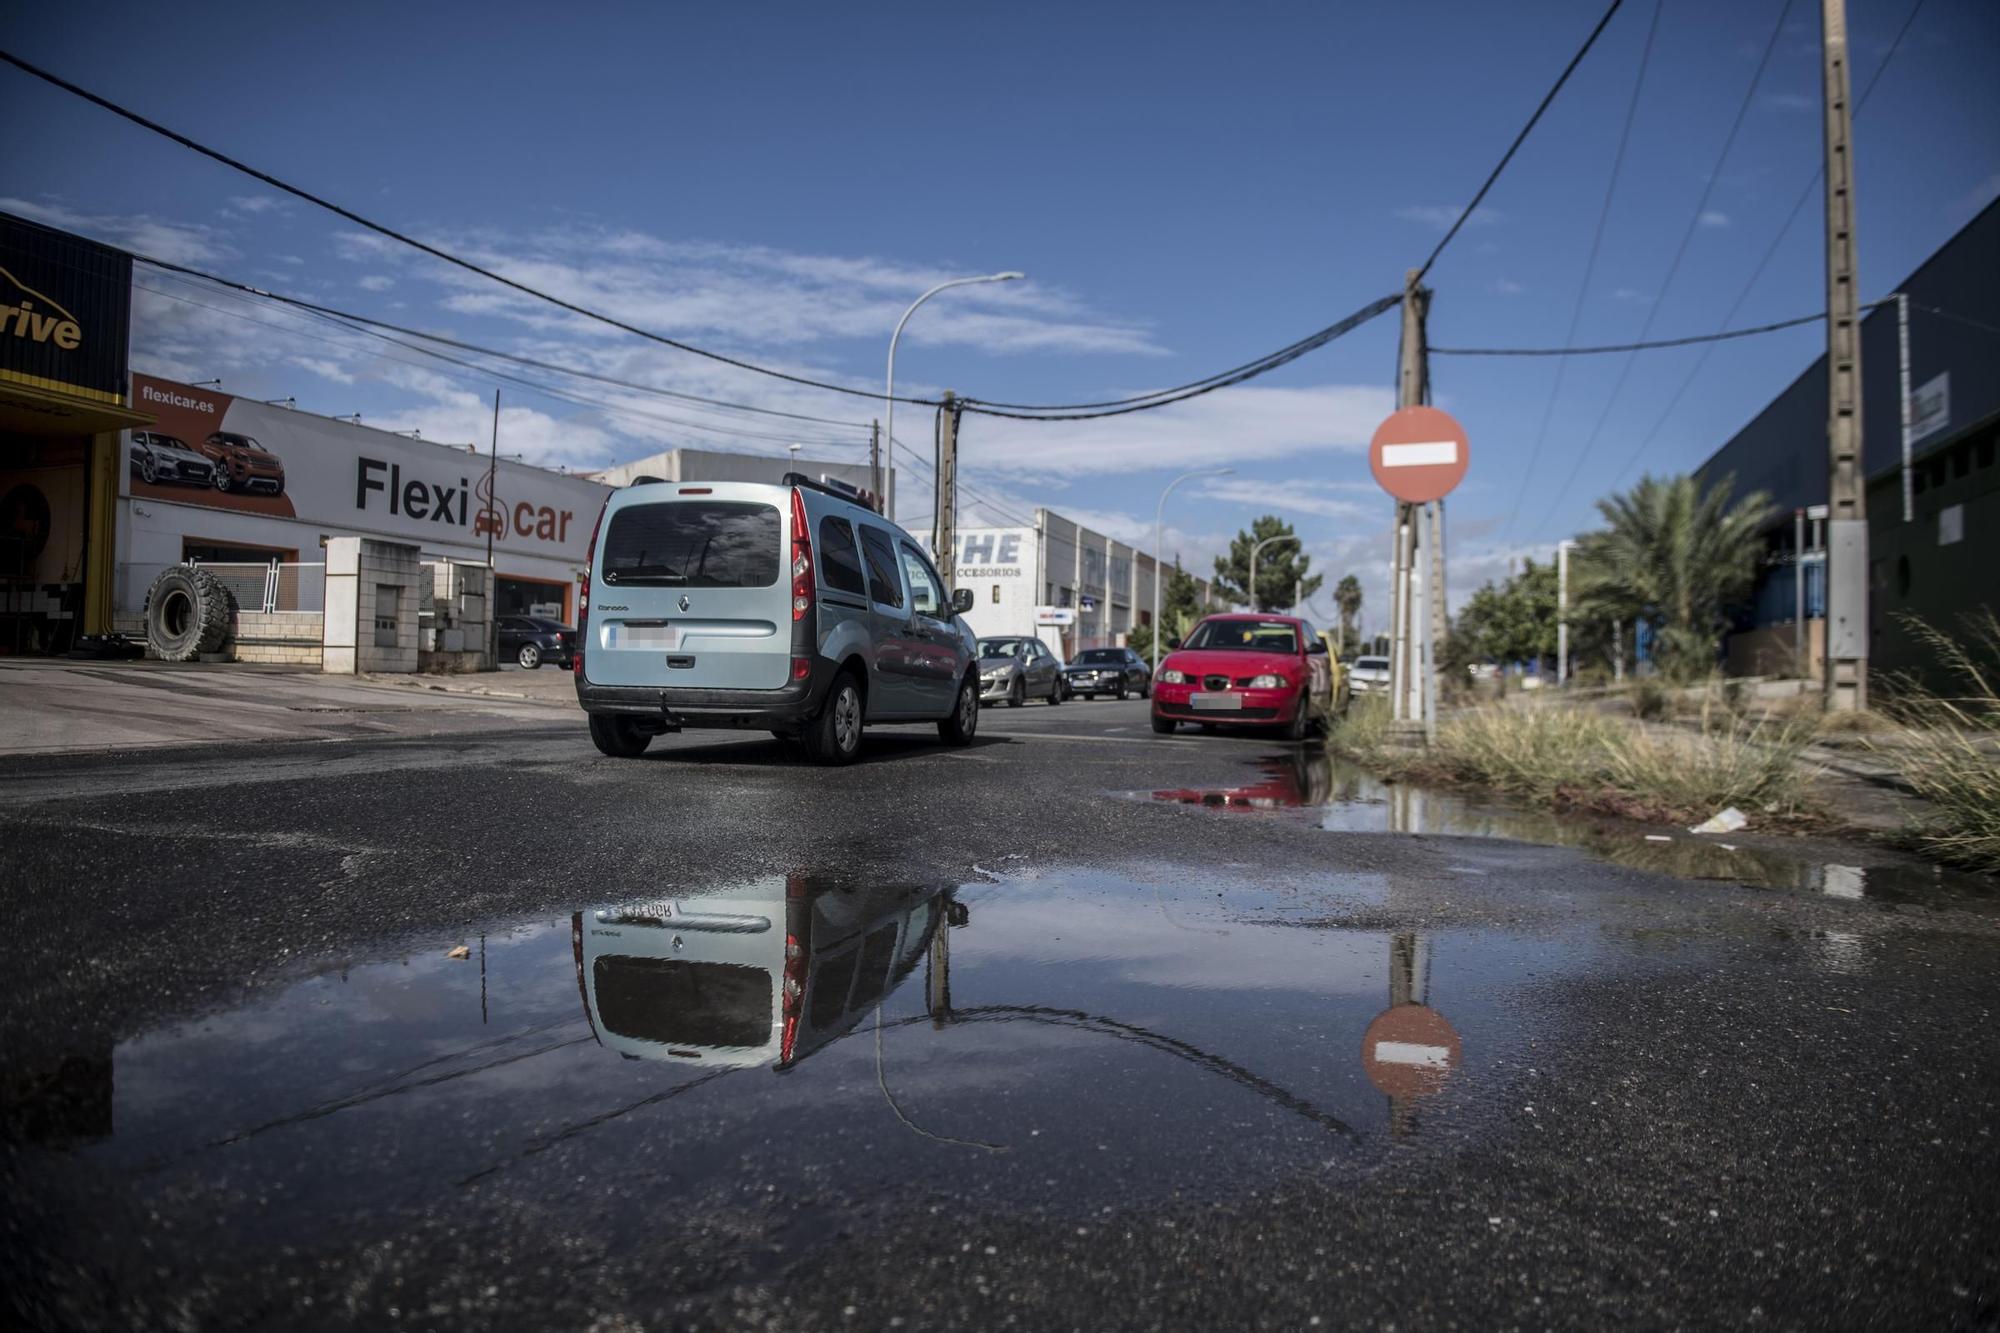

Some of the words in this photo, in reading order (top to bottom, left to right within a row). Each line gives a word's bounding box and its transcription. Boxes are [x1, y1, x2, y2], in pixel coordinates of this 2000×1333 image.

[142, 385, 215, 413] flexicar.es
[356, 456, 468, 526] Flexi
[514, 501, 573, 543] car
[957, 567, 1021, 578] CCESORIOS
